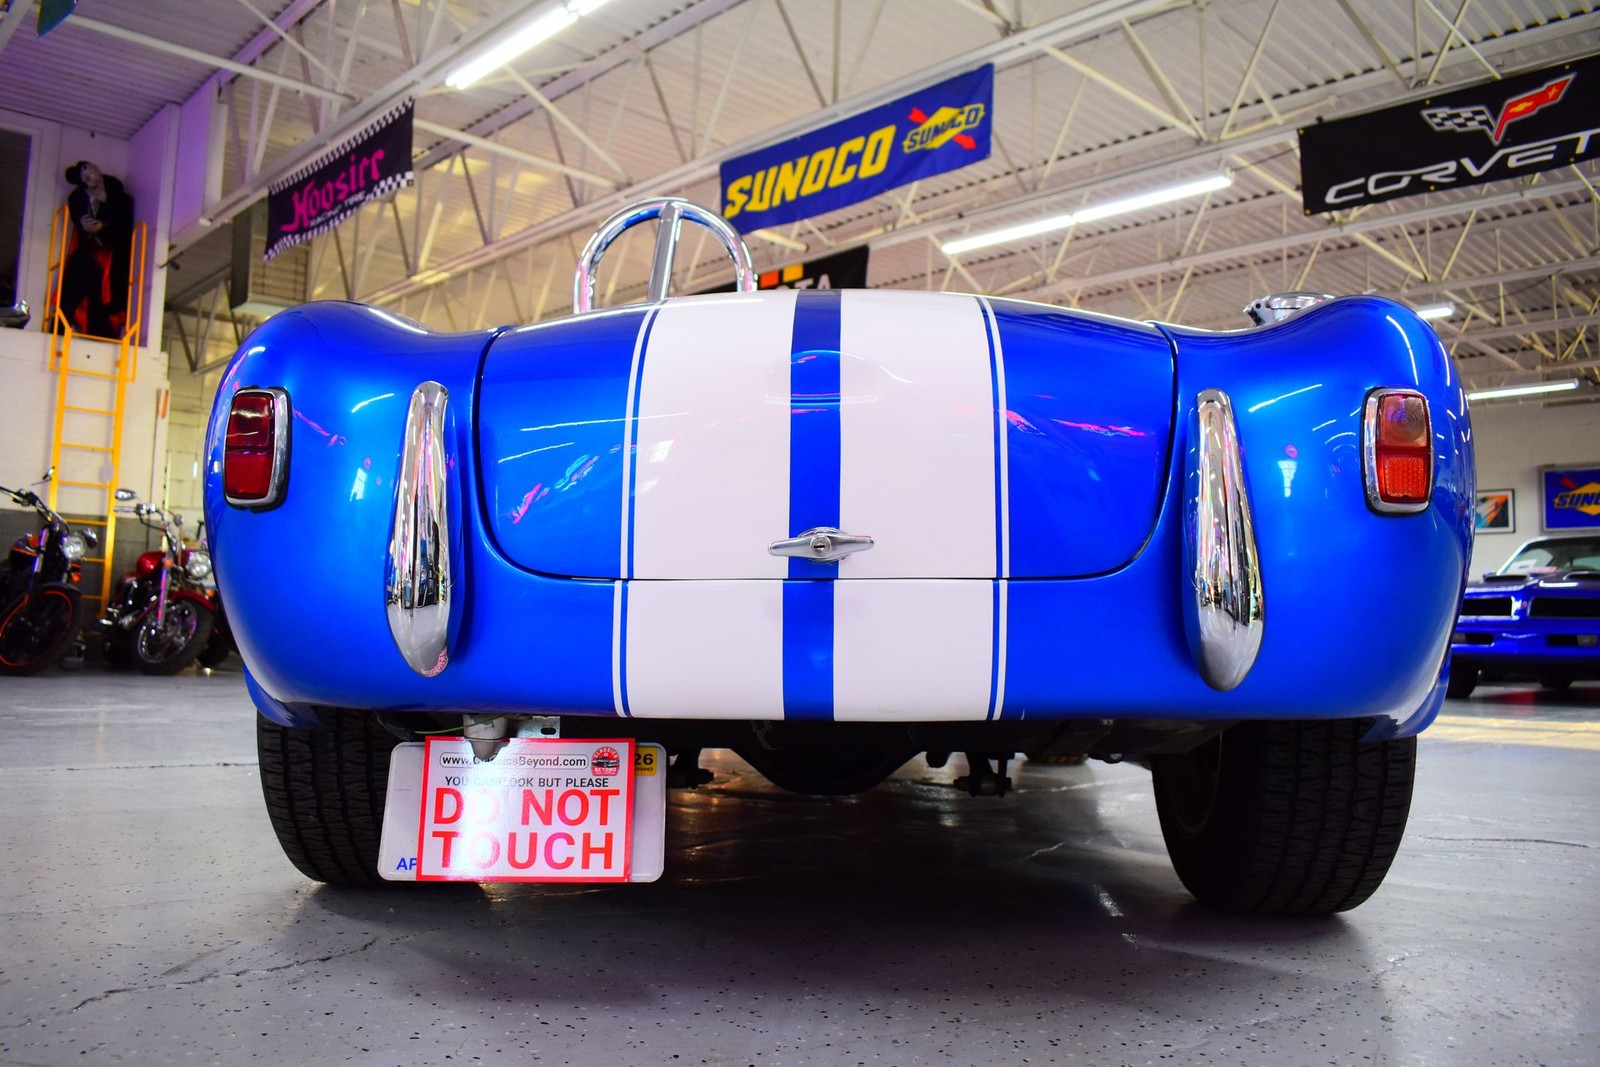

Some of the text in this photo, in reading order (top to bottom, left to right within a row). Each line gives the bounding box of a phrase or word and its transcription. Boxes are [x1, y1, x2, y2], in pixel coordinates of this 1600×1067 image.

[907, 107, 981, 150] SUNOCO
[723, 124, 897, 220] SUNOCO
[442, 755, 586, 768] www.CsicsBeyond.com
[445, 776, 470, 787] YOU
[538, 777, 562, 788] BUT
[565, 778, 609, 788] PLEASE
[433, 787, 620, 827] DO NOT
[431, 830, 614, 870] TOUCH
